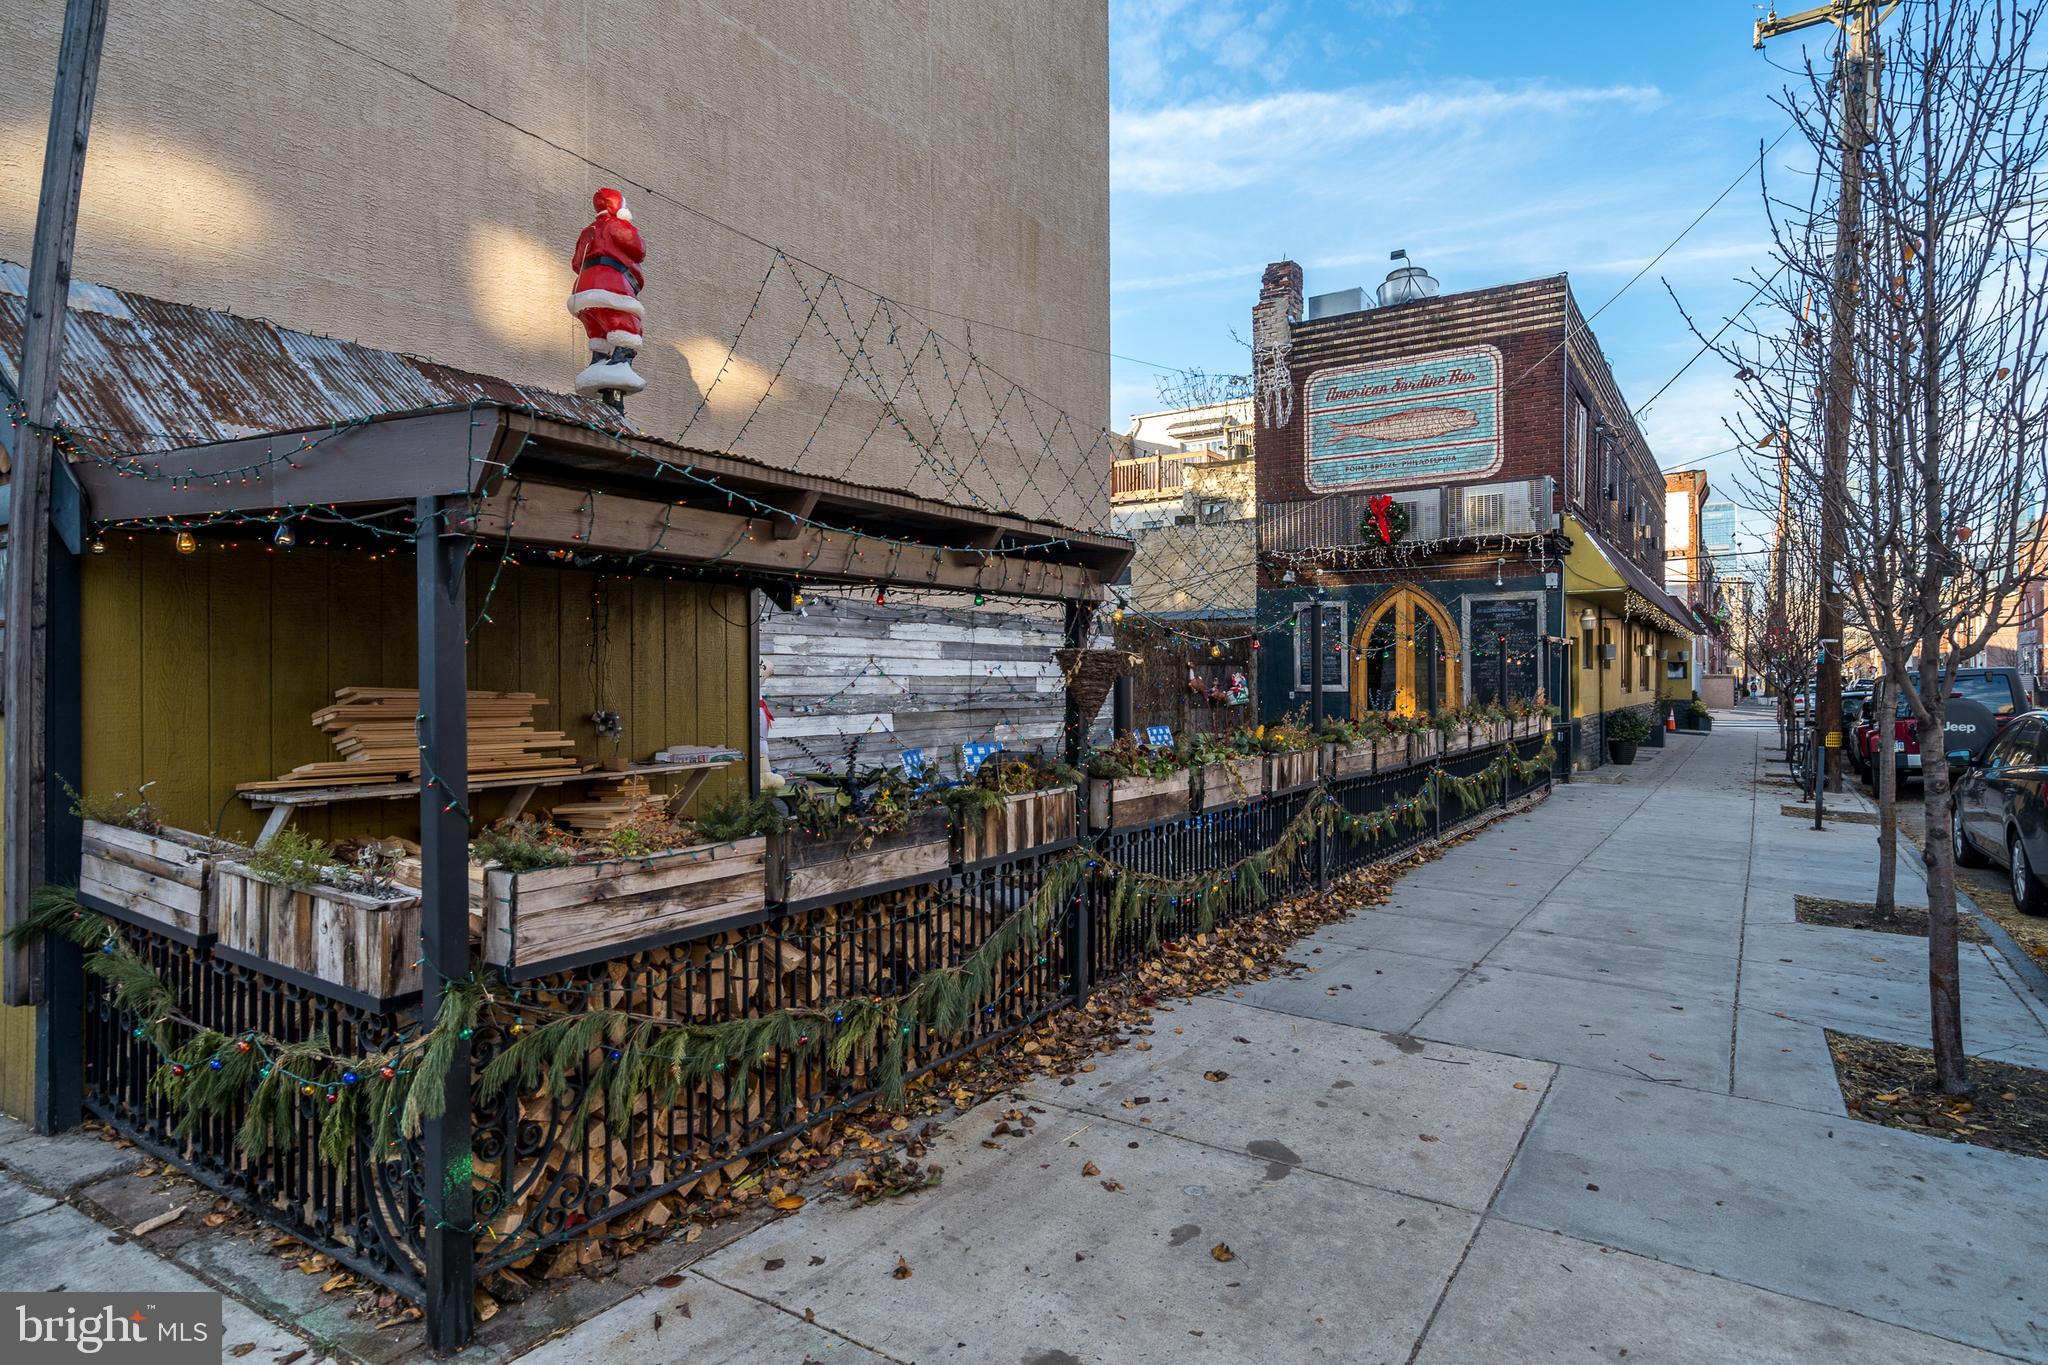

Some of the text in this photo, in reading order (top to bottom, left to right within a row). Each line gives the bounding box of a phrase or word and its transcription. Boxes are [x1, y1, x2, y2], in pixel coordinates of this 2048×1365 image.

[1326, 367, 1478, 402] American Sardine Bar
[1345, 455, 1457, 473] POINT BREEZE PHILADELPHIA
[1943, 721, 1976, 733] Jeep
